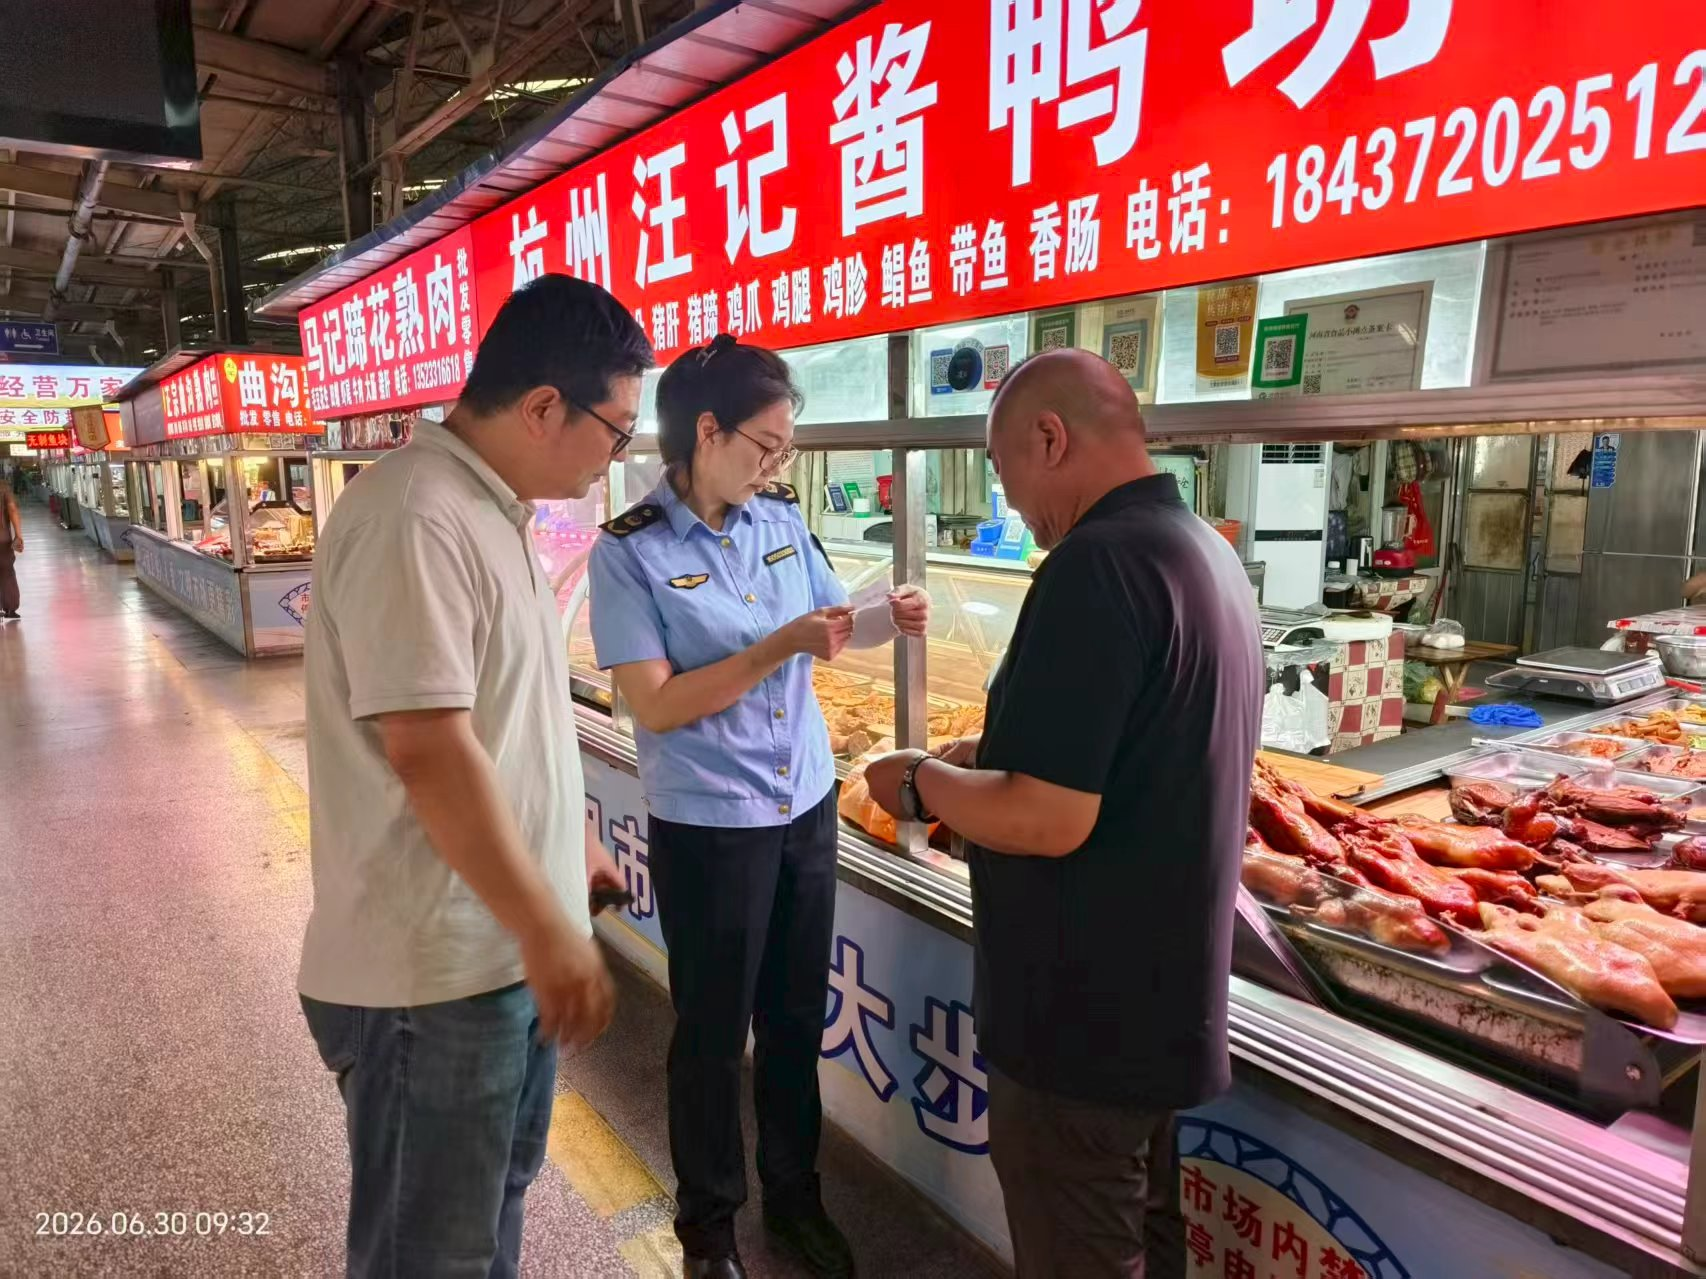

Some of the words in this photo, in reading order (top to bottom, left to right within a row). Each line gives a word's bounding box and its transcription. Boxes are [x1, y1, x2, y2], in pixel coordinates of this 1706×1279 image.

[652, 301, 680, 351] 猪肝
[687, 290, 718, 344] 猪蹄
[727, 281, 762, 337] 鸡爪
[772, 264, 811, 328] 鸡腿
[823, 251, 868, 319] 鸡胗
[881, 237, 932, 309] 鲳鱼
[950, 218, 1008, 296] 带鱼
[1029, 193, 1100, 283] 香肠
[1265, 47, 1706, 228] 18437202512
[303, 254, 457, 382] 马记蹄花熟肉
[240, 410, 259, 427] 批发
[263, 410, 281, 427] 零售
